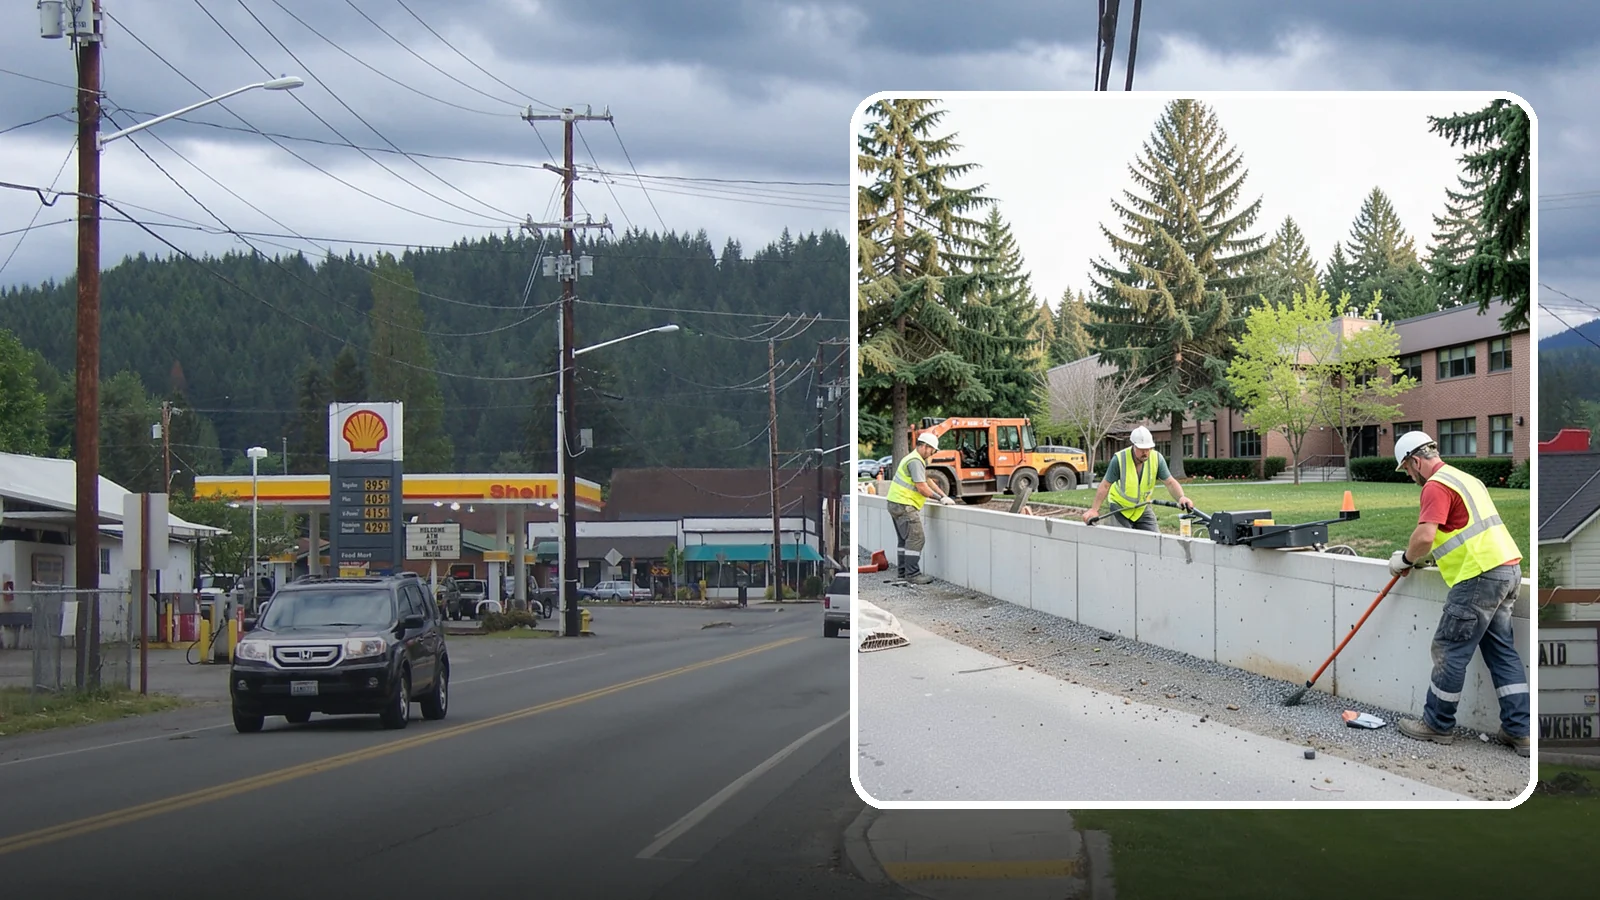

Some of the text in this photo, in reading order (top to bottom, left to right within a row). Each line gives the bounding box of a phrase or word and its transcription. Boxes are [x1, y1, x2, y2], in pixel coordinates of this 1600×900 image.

[366, 480, 383, 490] 395
[490, 484, 547, 498] Shell
[366, 494, 383, 504] 405
[366, 508, 383, 517] 415
[366, 522, 383, 532] 429
[1539, 643, 1567, 666] AID
[1539, 716, 1592, 739] WKENS
